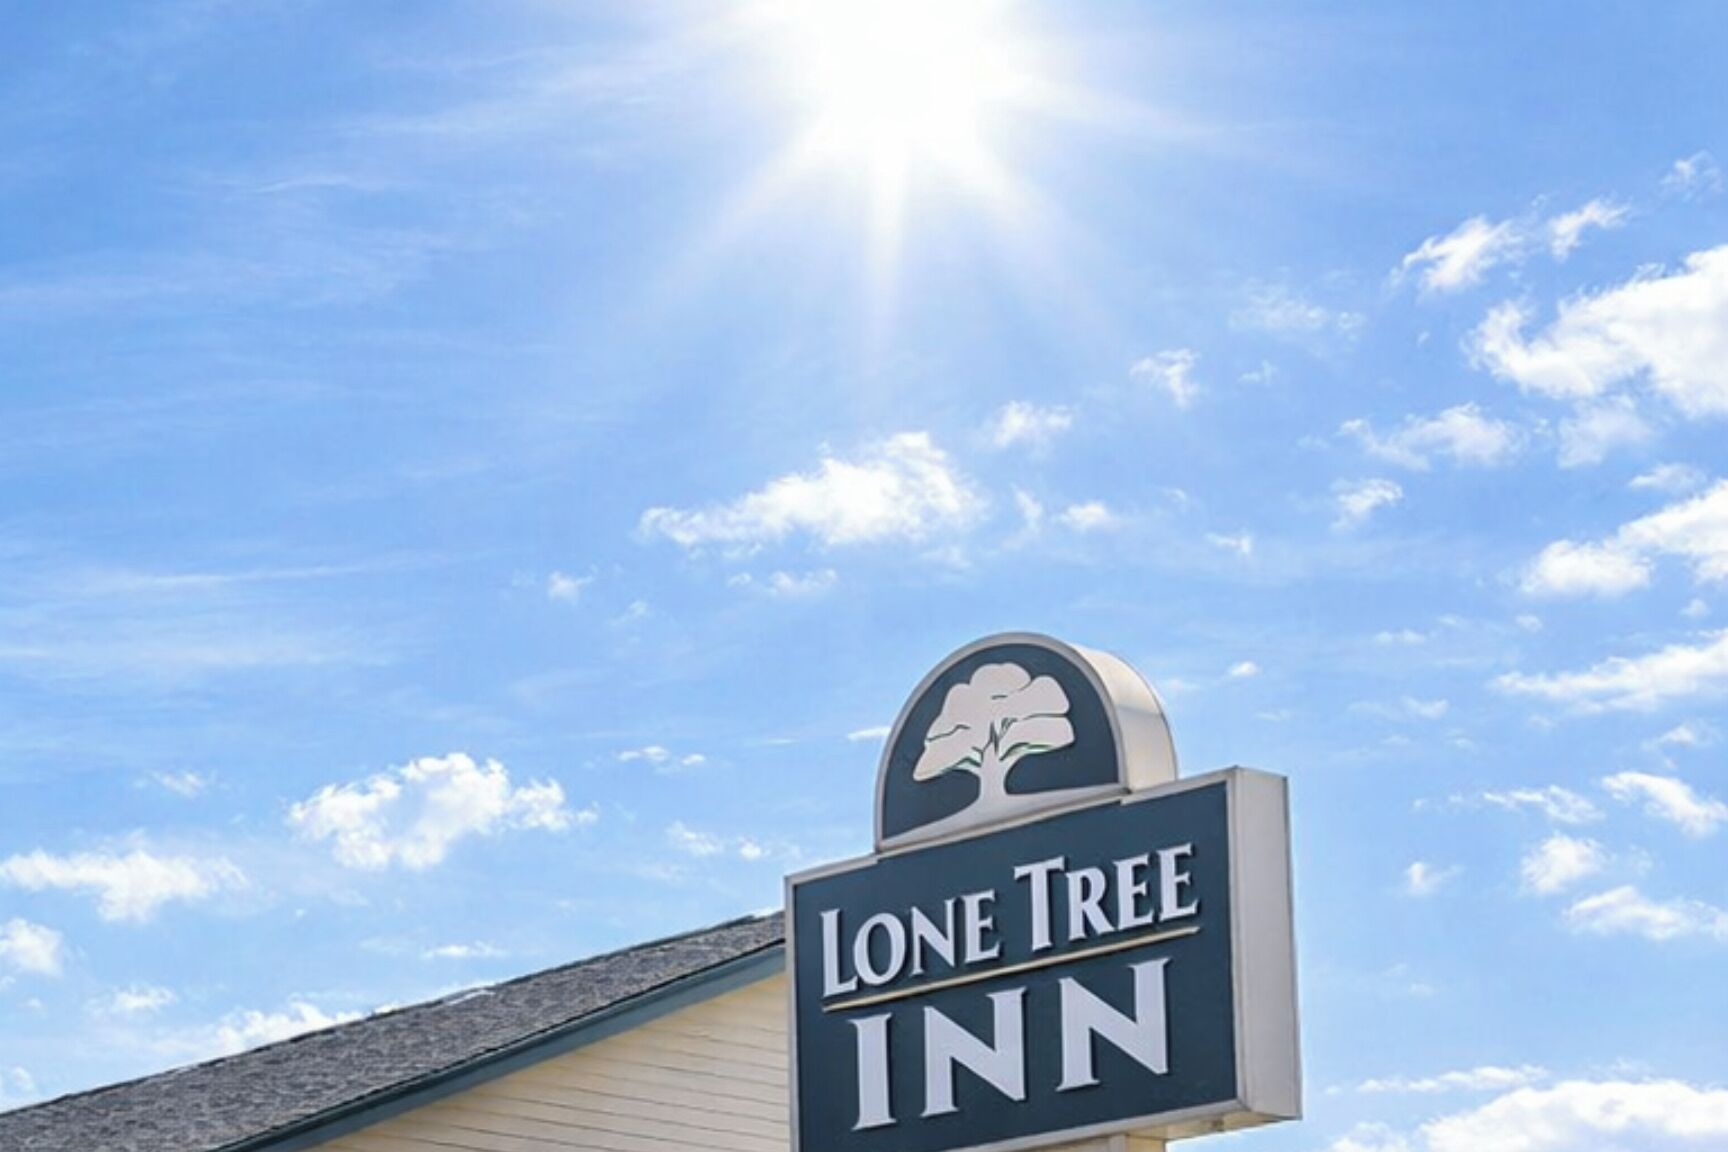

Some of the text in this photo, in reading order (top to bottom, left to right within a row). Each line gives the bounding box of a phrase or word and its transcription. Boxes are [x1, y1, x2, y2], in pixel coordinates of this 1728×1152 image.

[820, 843, 1199, 998] LONE TREE
[847, 957, 1171, 1131] INN
